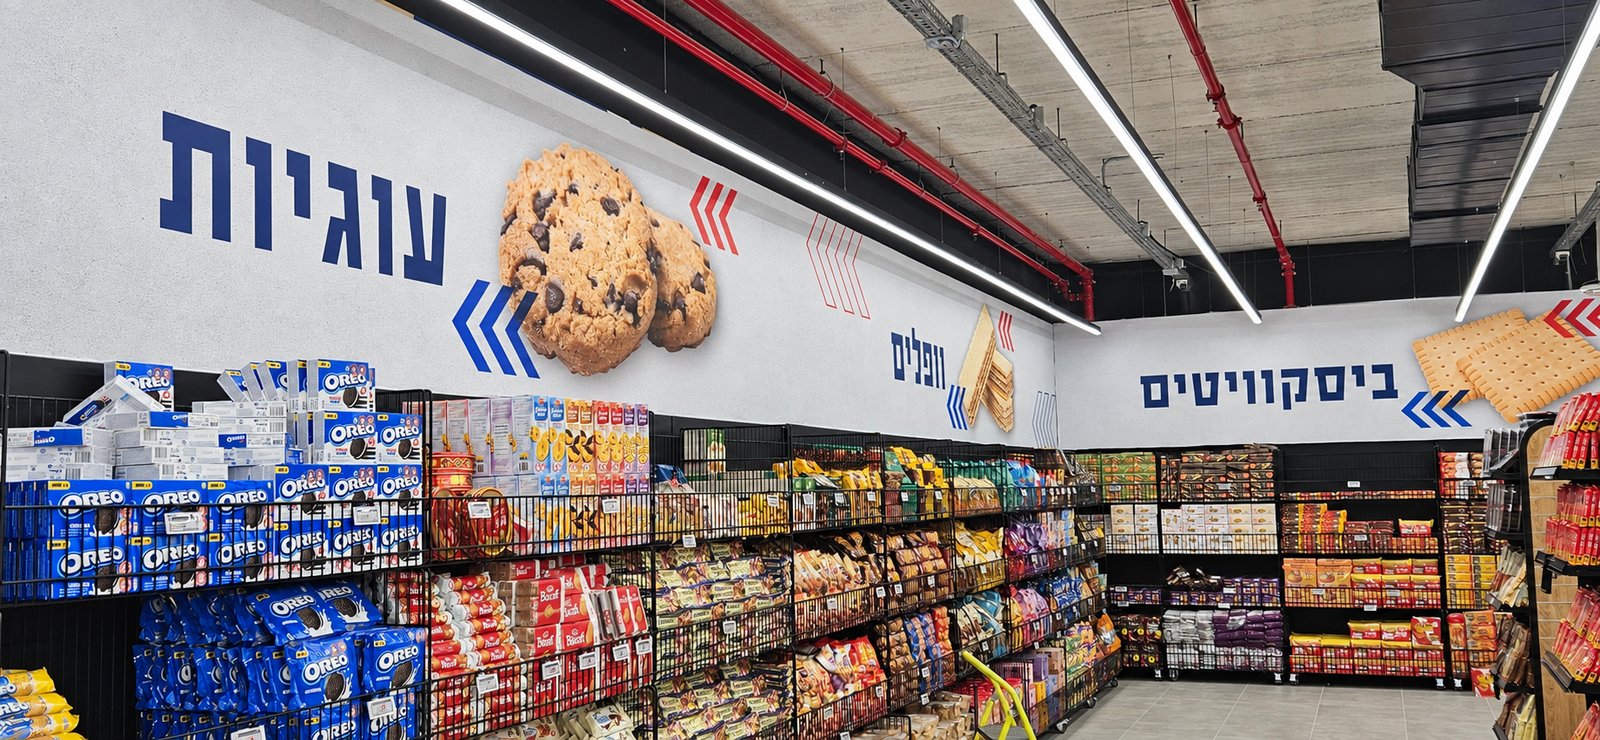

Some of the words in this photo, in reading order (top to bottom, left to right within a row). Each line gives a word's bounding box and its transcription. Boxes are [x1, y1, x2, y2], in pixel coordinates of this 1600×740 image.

[160, 110, 446, 285] עוגיות
[890, 327, 946, 390] וופלים
[127, 376, 170, 390] OREO
[324, 372, 367, 391] OREO
[1140, 363, 1398, 410] ביסקוויטים
[331, 424, 375, 442] OREO
[382, 426, 420, 442] OREO
[280, 478, 326, 498] OREO
[334, 477, 375, 496] OREO
[381, 475, 419, 496] OREO
[60, 490, 124, 514] OREO
[143, 490, 201, 513] OREO
[217, 490, 268, 511] OREO
[280, 531, 326, 555] OREO
[333, 527, 375, 551] OREO
[381, 525, 419, 547] OREO
[60, 547, 124, 574] OREO
[142, 544, 200, 569] OREO
[218, 540, 267, 564] OREO
[317, 586, 353, 601] REO
[271, 595, 315, 617] OREO
[304, 654, 349, 683] OREO
[378, 645, 419, 670] OREO
[0, 702, 30, 716] REO
